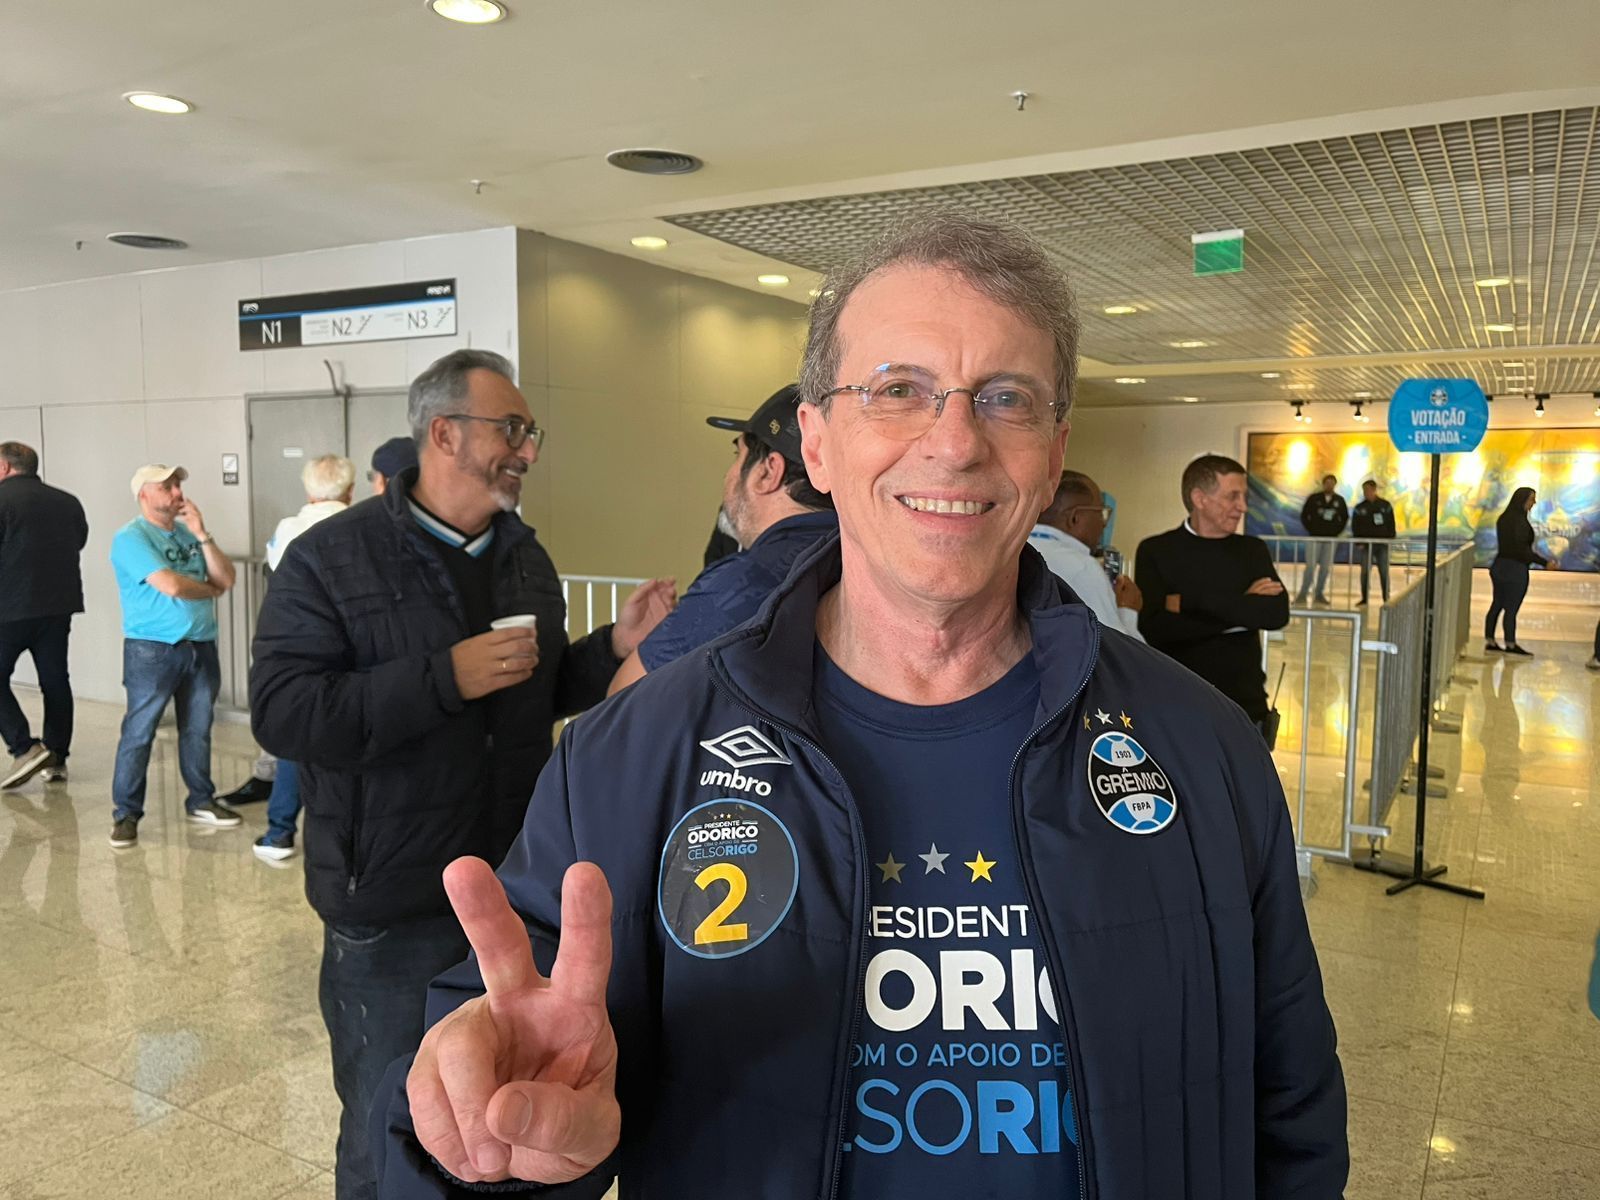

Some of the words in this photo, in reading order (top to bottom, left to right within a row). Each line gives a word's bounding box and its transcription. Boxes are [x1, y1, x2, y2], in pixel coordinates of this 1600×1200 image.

[331, 318, 353, 337] N2
[407, 310, 428, 330] N3
[261, 320, 282, 345] N1
[1411, 407, 1466, 429] VOTAÇÃO
[1414, 430, 1460, 444] ENTRADA
[700, 769, 772, 797] umbro
[1096, 767, 1167, 795] GRÊMIO
[1132, 801, 1152, 812] FBPA
[687, 825, 759, 844] ODORICO
[704, 819, 740, 829] PRESIDENTE
[694, 862, 748, 945] 2
[864, 949, 1060, 1032] ORI
[895, 1042, 918, 1067] O
[927, 1042, 1021, 1067] APOIO
[1031, 1042, 1067, 1067] DE
